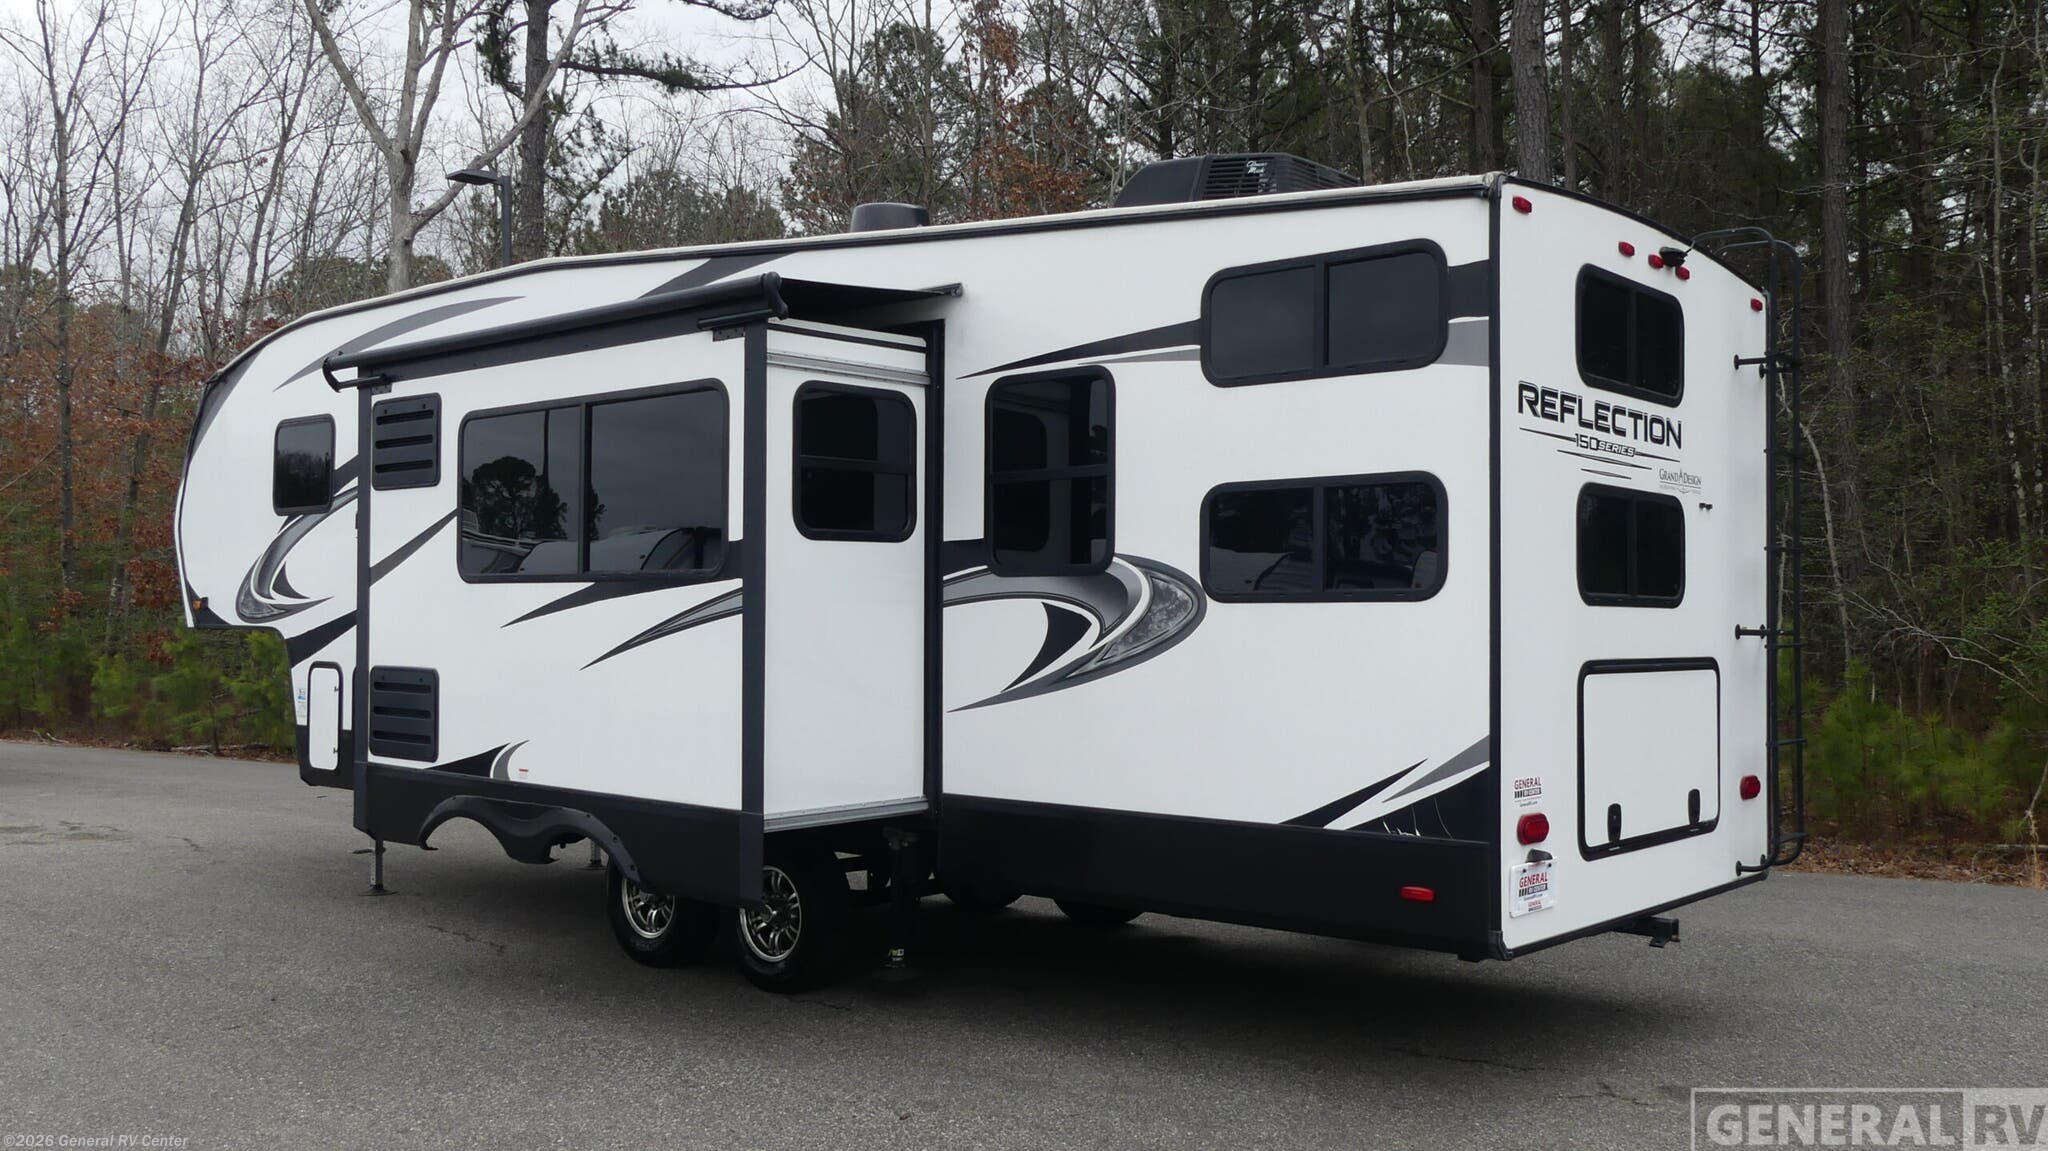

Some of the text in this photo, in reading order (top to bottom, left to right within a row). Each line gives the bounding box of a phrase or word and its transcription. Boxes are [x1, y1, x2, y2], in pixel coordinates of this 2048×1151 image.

[1518, 380, 1682, 449] REFLECTION
[1575, 433, 1634, 456] 150 SERIES
[1514, 777, 1541, 790] GENERAL
[1519, 872, 1548, 888] GENERAL
